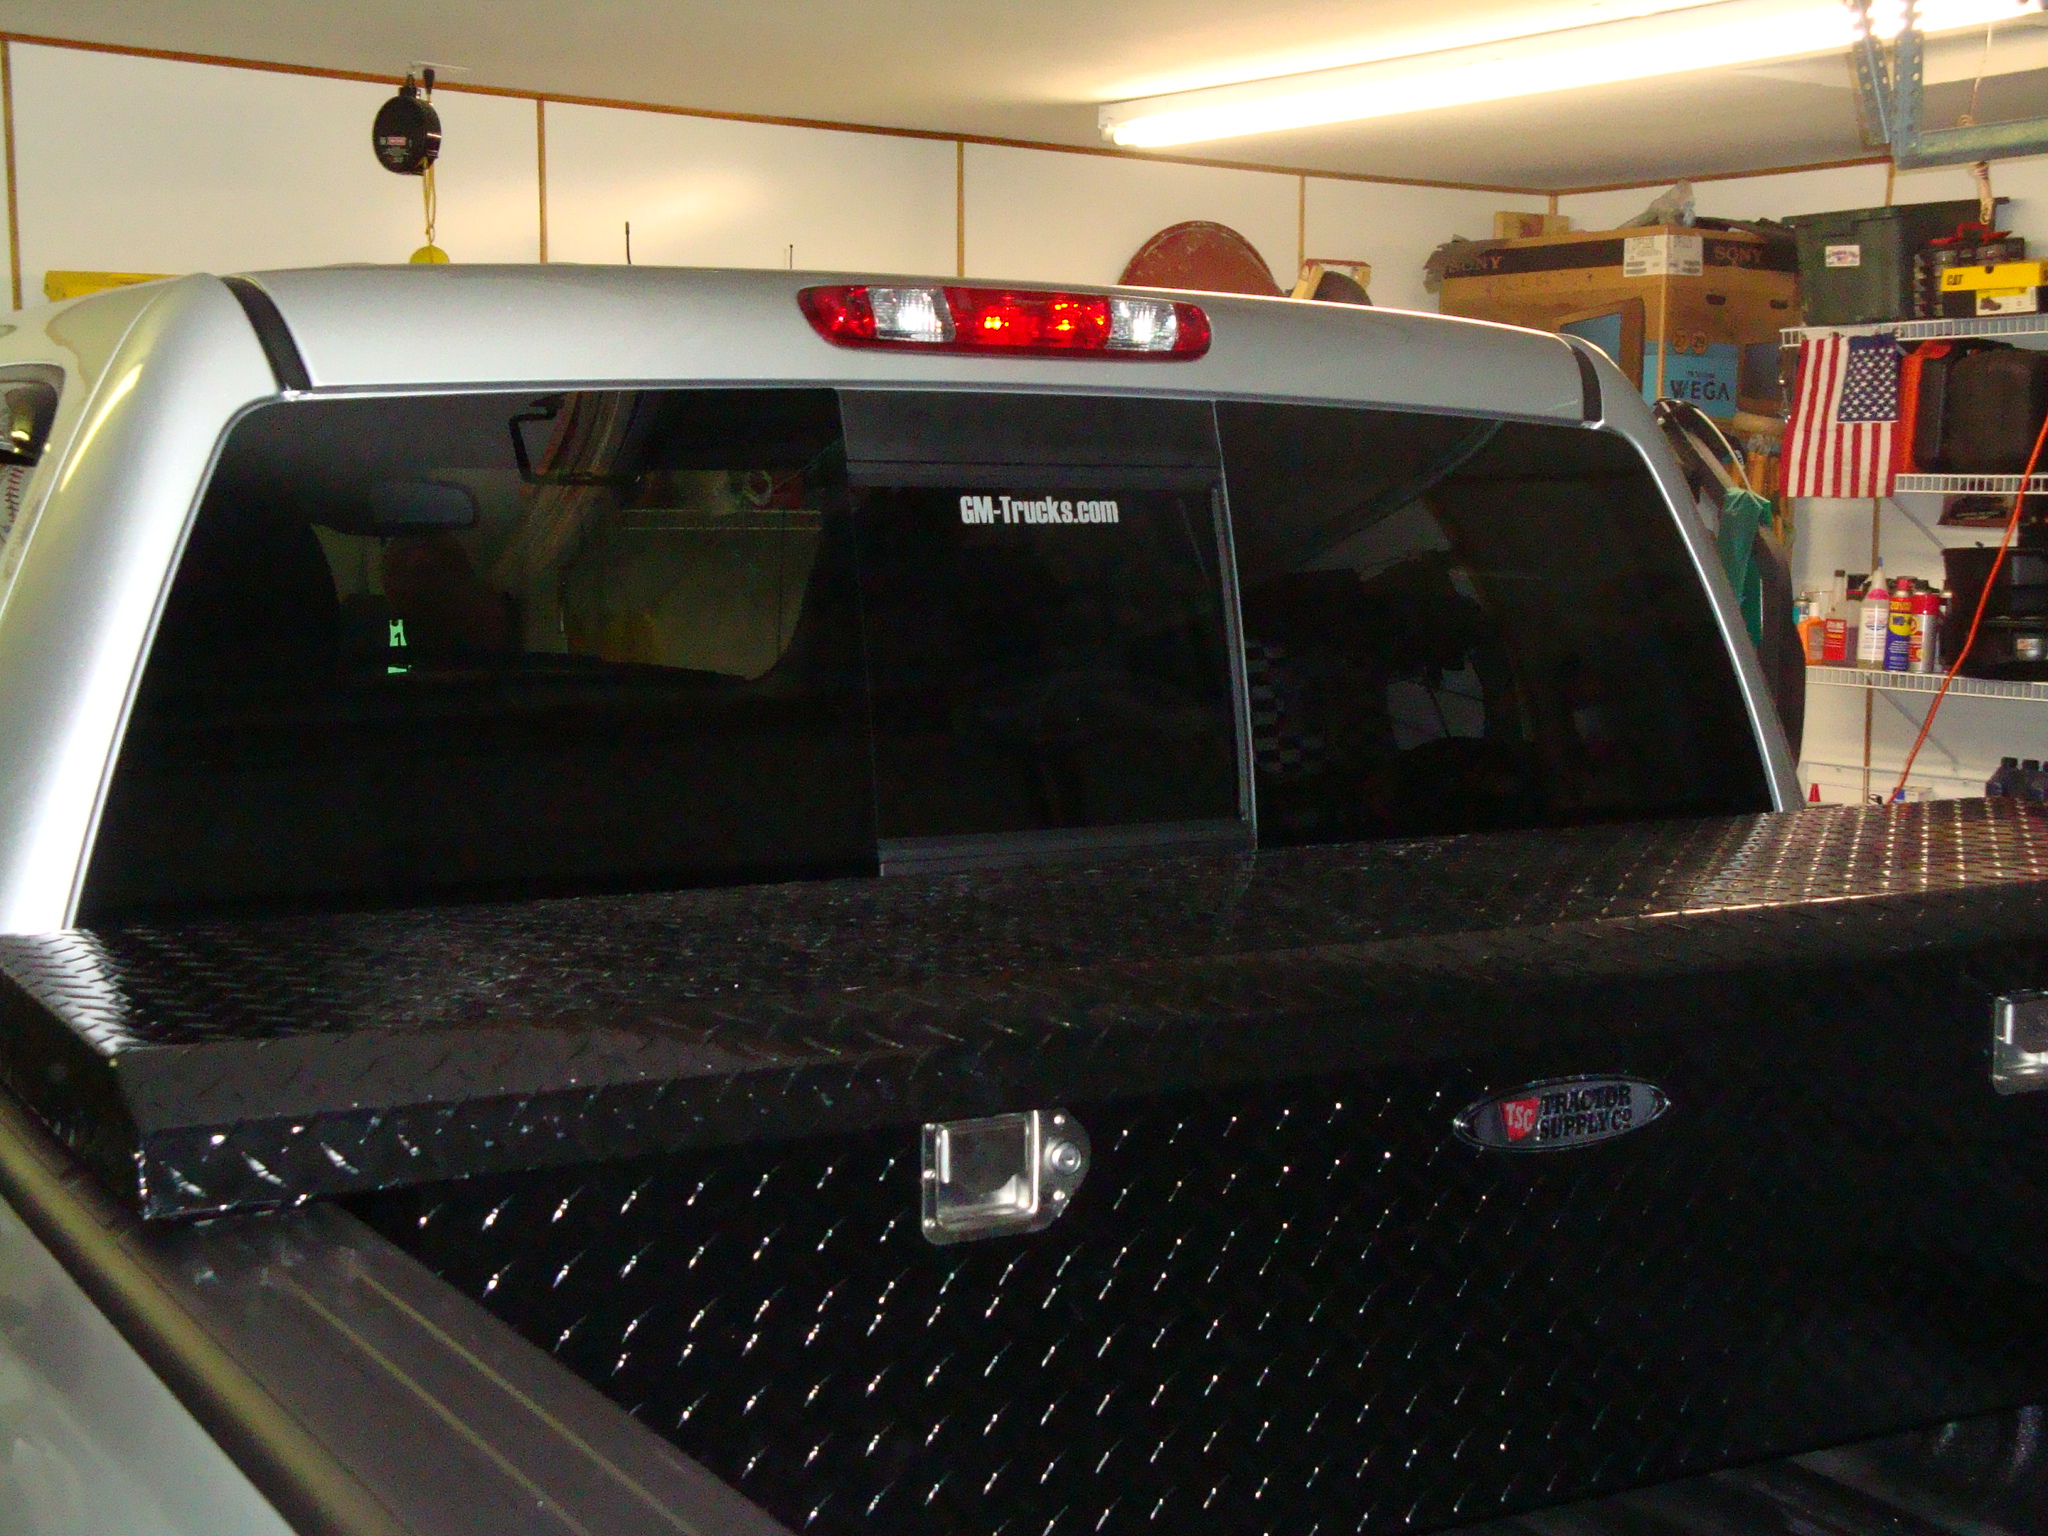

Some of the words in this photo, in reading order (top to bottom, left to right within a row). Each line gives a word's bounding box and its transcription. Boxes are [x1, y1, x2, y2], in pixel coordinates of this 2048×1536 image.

[1713, 245, 1763, 264] SONY
[1945, 273, 1964, 286] CAT
[1669, 379, 1730, 401] WEGA
[959, 495, 1120, 524] GM-Trucks.com
[1541, 1085, 1632, 1116] TRACTOR
[1505, 1102, 1534, 1132] TSC
[1540, 1110, 1607, 1139] SUPPLY
